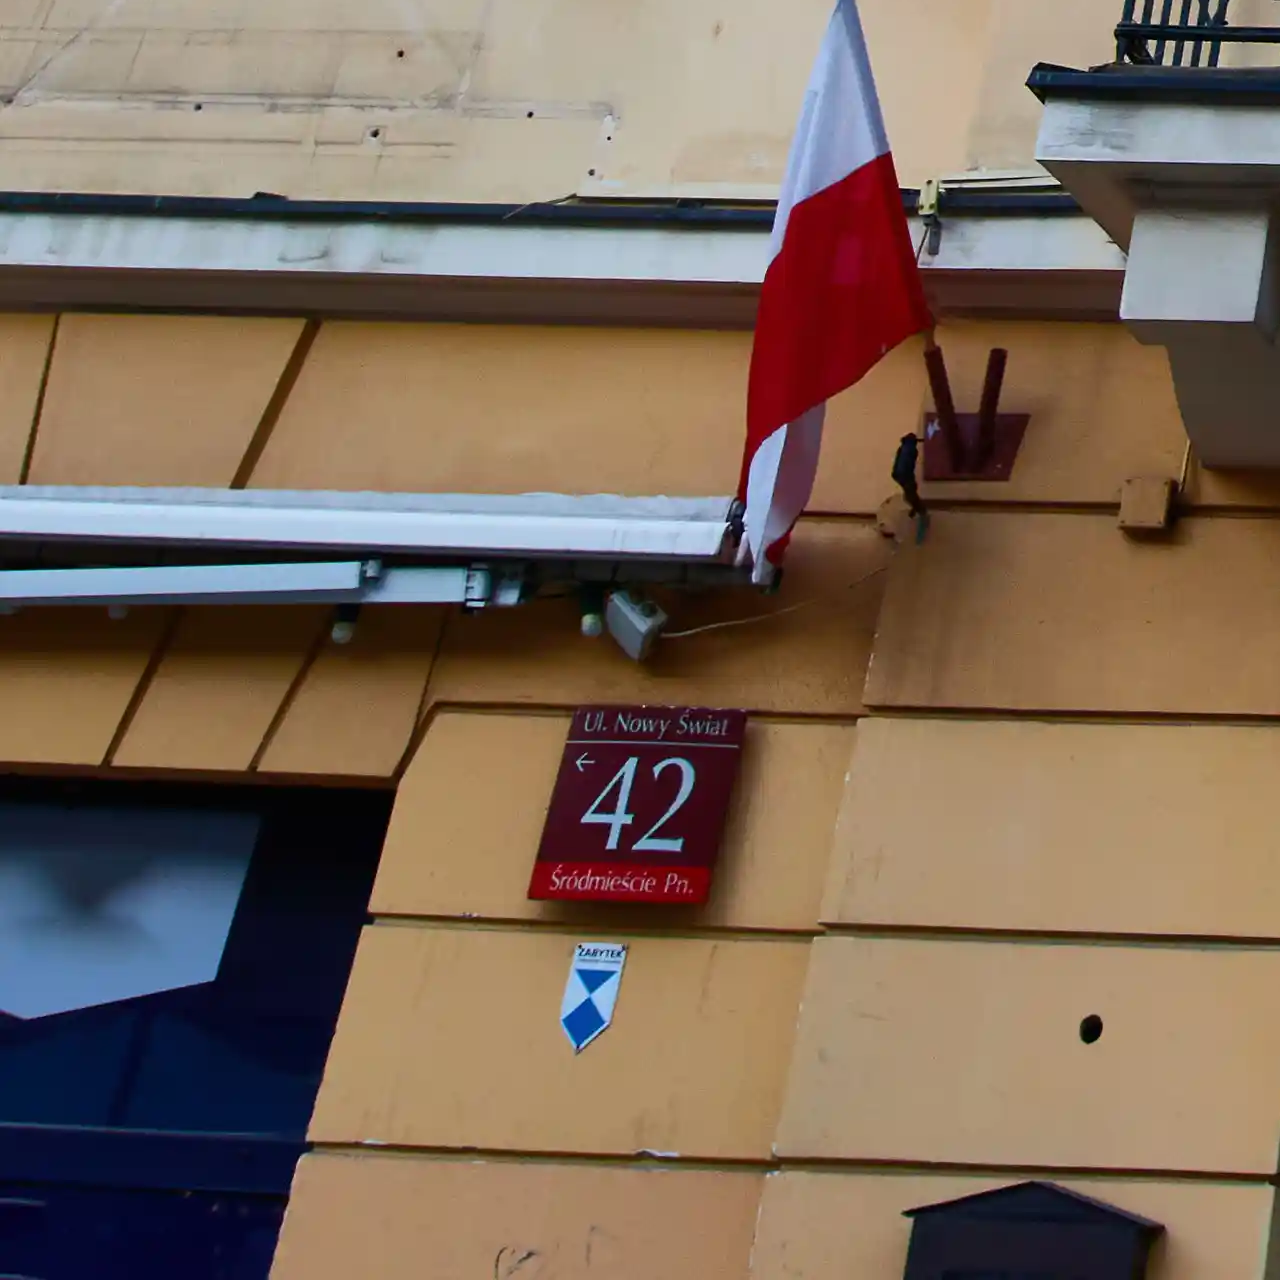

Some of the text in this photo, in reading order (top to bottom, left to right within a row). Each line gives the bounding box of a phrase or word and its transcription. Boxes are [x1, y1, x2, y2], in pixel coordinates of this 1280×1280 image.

[583, 708, 731, 740] Ul. Nowy Świat
[580, 756, 697, 853] 42
[549, 864, 695, 895] Śródmieście Pn.
[578, 947, 624, 958] ZABYTEK
